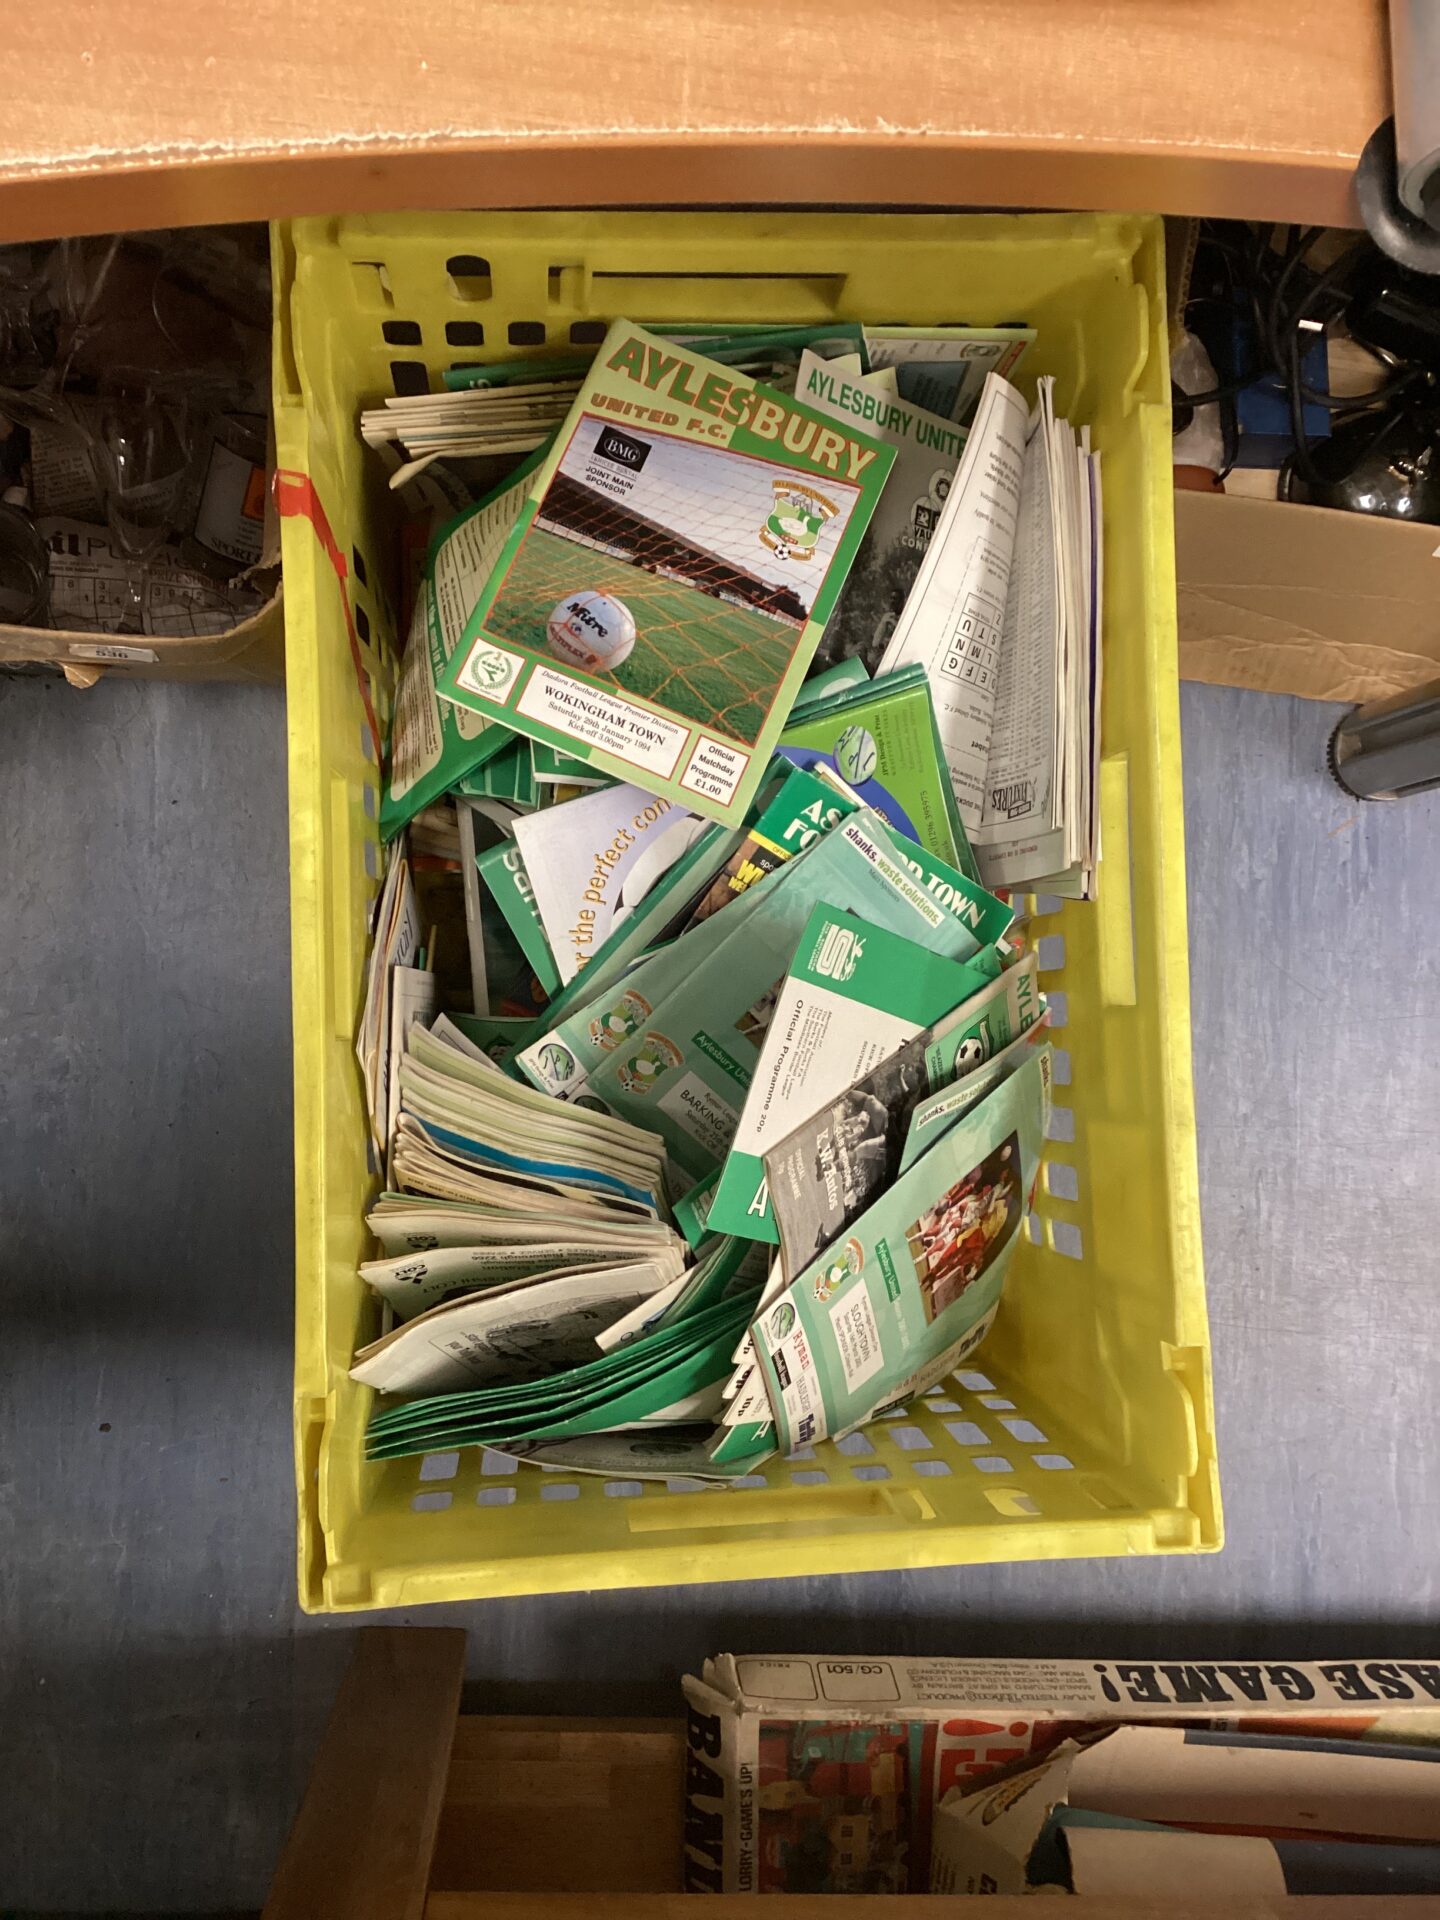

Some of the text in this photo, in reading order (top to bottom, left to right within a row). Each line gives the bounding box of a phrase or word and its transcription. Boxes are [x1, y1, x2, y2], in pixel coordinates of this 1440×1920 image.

[591, 393, 728, 439] UNITED F.C.
[606, 337, 877, 481] AYLESBURY
[807, 368, 912, 437] AYLESBURY
[608, 440, 638, 460] BMG
[586, 466, 633, 490] JOINT MAIN
[586, 475, 626, 496] SPONSOR
[961, 619, 971, 632] U
[977, 627, 986, 639] T
[954, 637, 992, 663] L M N
[947, 656, 987, 683] E F G
[541, 668, 679, 735] Diadora Football League Premier Division
[543, 684, 626, 729] WOKINGHAM
[627, 721, 666, 746] TOWN
[547, 700, 651, 752] Saturday 29th January 1994
[567, 719, 625, 751] Kick-off 3.00pm
[697, 754, 735, 776] Matchday
[707, 744, 735, 762] Official
[689, 763, 733, 789] Programme
[693, 777, 721, 795] £1.00
[569, 909, 596, 945] the
[583, 829, 635, 905] perfect
[844, 824, 882, 862] shanks.
[875, 857, 906, 888] waste
[899, 880, 943, 925] solutions.
[926, 867, 986, 929] TOWN
[694, 1032, 738, 1072] Aylesbury
[756, 999, 804, 1133] Official Programme 20p
[678, 1088, 726, 1131] BARKING
[850, 1304, 870, 1363] SLOUGH TOWN
[793, 1333, 810, 1370] Ryman
[738, 1395, 753, 1418] 10p
[826, 1663, 883, 1674] CG/501
[1093, 1663, 1315, 1702] GAME!
[740, 1762, 752, 1784] UP!
